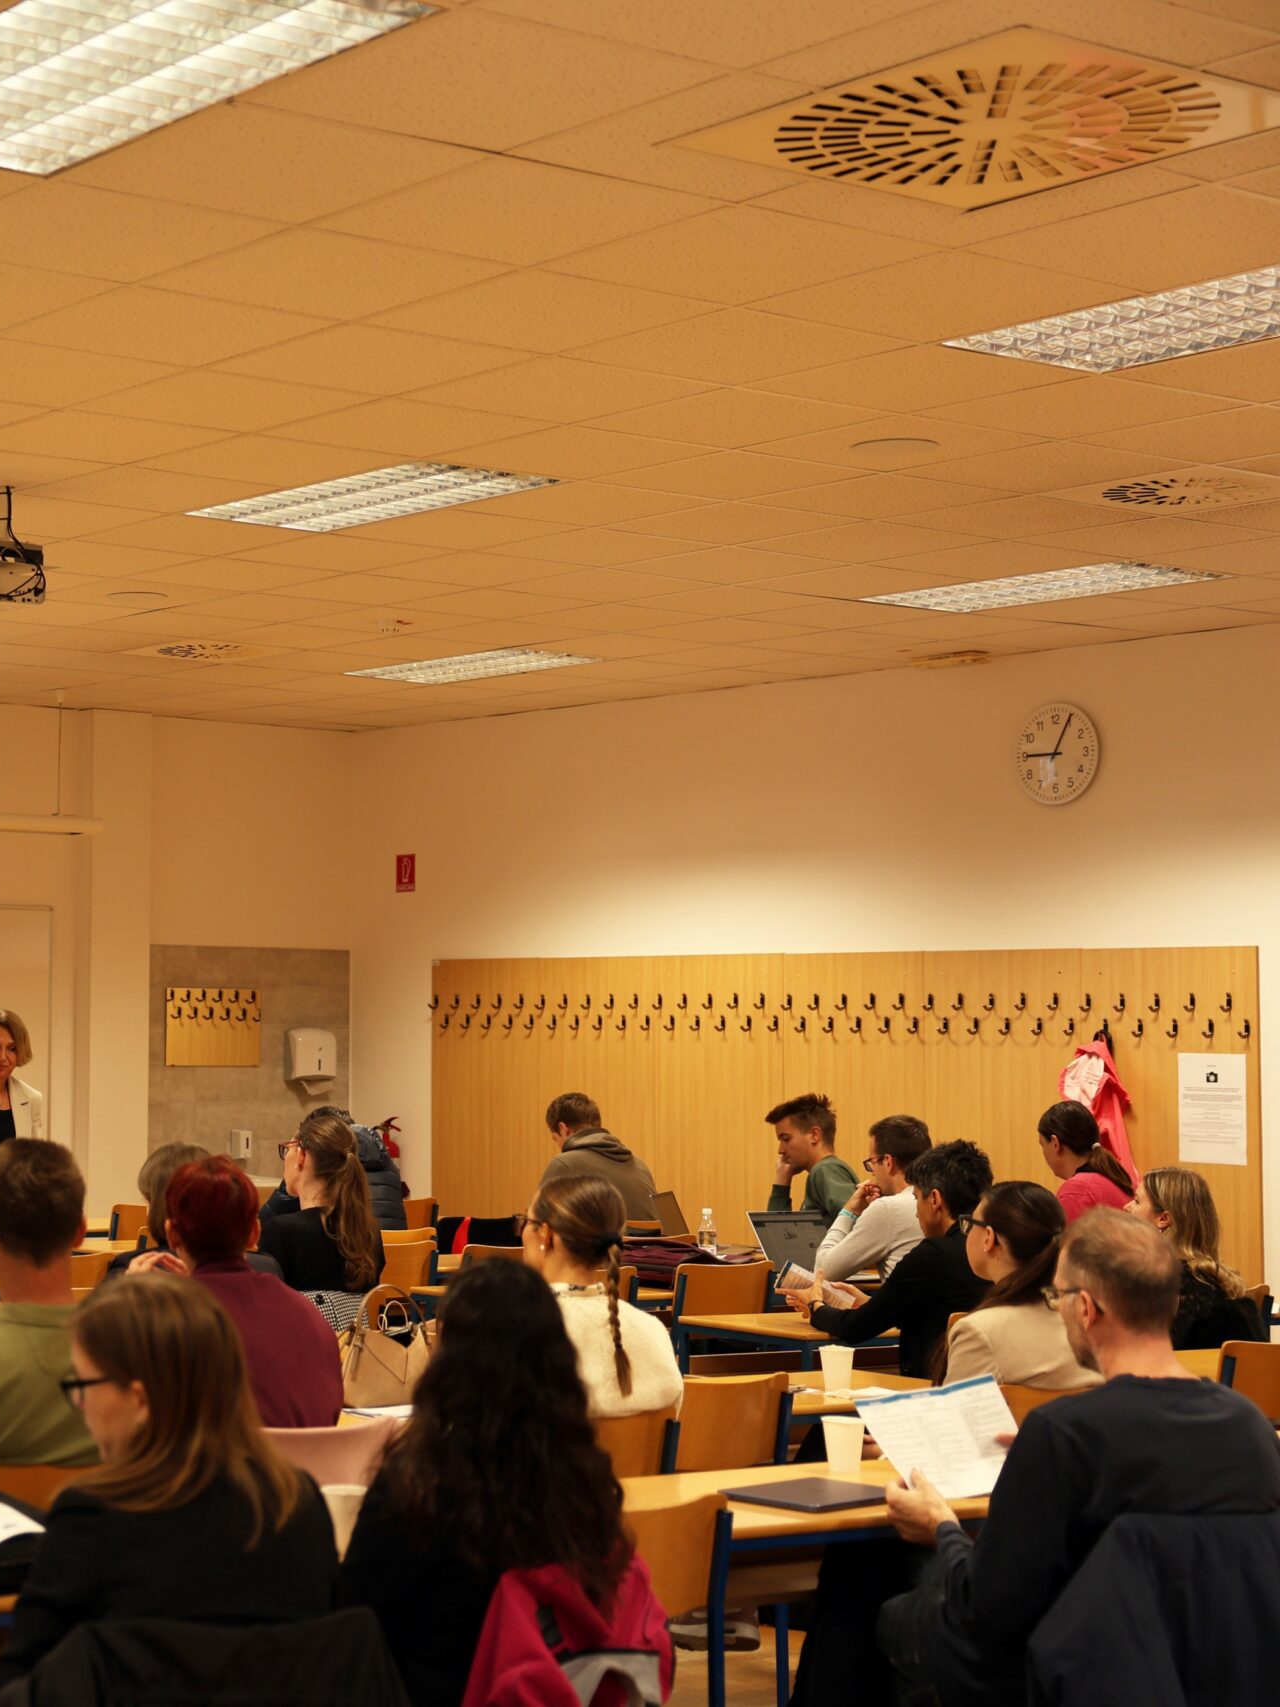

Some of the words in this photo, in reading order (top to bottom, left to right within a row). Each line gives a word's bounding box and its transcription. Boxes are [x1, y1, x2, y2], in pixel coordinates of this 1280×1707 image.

[1050, 714, 1061, 725] 12
[1036, 721, 1044, 731] 11
[1025, 733, 1035, 743] 10
[1078, 729, 1085, 739] 2
[1083, 746, 1090, 757] 3
[1022, 752, 1029, 762] 9
[1078, 764, 1084, 774] 4
[1026, 769, 1033, 780] 8
[1037, 779, 1043, 790] 7
[1067, 777, 1074, 788] 5
[1052, 783, 1059, 793] 6
